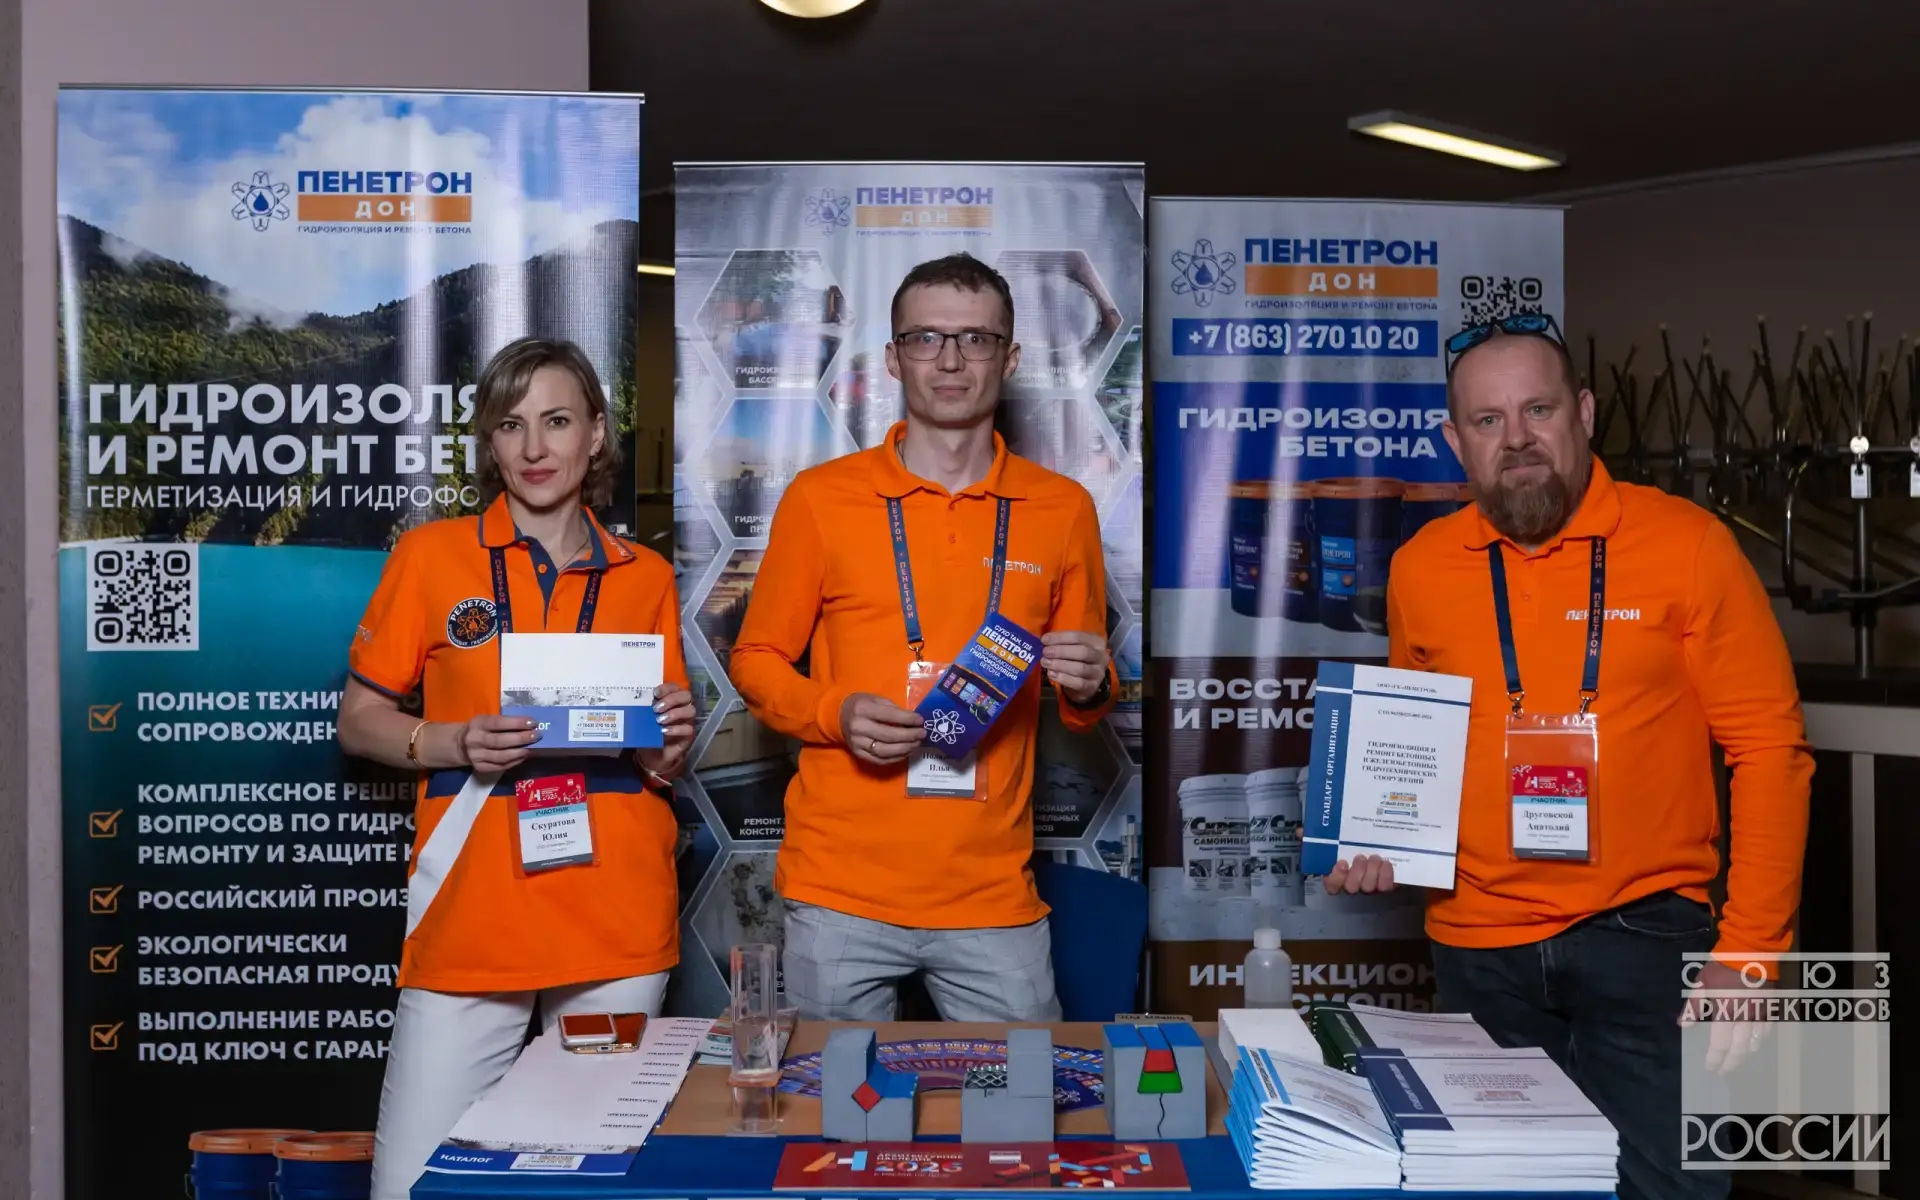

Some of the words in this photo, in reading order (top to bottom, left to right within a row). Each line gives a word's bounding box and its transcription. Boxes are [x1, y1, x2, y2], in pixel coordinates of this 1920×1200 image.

[298, 171, 472, 194] ПЕНЕТРОН
[856, 187, 993, 204] ПЕНЕТРОН
[355, 201, 415, 219] ДОН
[298, 226, 383, 234] ГИДРОИЗОЛЯЦИЯ
[435, 226, 472, 234] БЕТОНА
[1245, 238, 1438, 265] ПЕНЕТРОН
[1309, 272, 1376, 292] ДОН
[1351, 302, 1393, 310] РЕМОНТ
[1396, 302, 1438, 310] БЕТОНА
[1189, 325, 1220, 349] +7
[1226, 322, 1292, 355] (863)
[1297, 325, 1345, 349] 270
[1351, 325, 1382, 350] 10
[1388, 326, 1419, 351] 20
[88, 435, 127, 475] И
[147, 434, 379, 475] РЕМОНТ
[1280, 436, 1438, 458] БЕТОНА
[87, 485, 301, 511] ГЕРМЕТИЗАЦИЯ
[312, 486, 331, 508] И
[900, 561, 914, 618] ПЕНЕТРОН
[450, 599, 498, 621] PENETRON
[994, 625, 1011, 637] СУХО
[1589, 592, 1601, 656] ПЕНЕТРОН
[981, 626, 1035, 664] ПЕНЕТРОН
[990, 644, 1015, 662] ДОН
[969, 647, 1018, 680] ГИДРОИЗОЛЯЦИЯ
[975, 644, 1020, 675] ПРОНИКАЮЩАЯ
[979, 661, 1001, 677] БЕТОНА
[138, 691, 250, 711] ПОЛНОЕ
[256, 691, 344, 710] ТЕХНИ
[1173, 707, 1200, 729] И
[1327, 709, 1339, 776] ОРГАНИЗАЦИИ
[1366, 749, 1395, 757] РЕМОНТ
[1396, 752, 1436, 761] БЕТОННЫХ
[138, 782, 336, 804] КОМПЛЕКСНОЕ
[1322, 779, 1333, 826] СТАНДАРТ
[534, 806, 570, 817] УЧАСТНИК
[743, 817, 782, 826] РЕМОНТ
[1522, 810, 1574, 820] Друговской
[138, 814, 283, 834] ВОПРОСОВ
[291, 813, 330, 833] ПО
[531, 818, 576, 831] Скуратова
[1527, 823, 1570, 831] Анатолий
[542, 831, 568, 842] Юлия
[138, 844, 259, 864] РЕМОНТУ
[267, 844, 284, 864] И
[292, 843, 397, 866] ЗАЩИТЕ
[138, 884, 316, 910] РОССИЙСКИЙ
[138, 934, 347, 955] ЭКОЛОГИЧЕСКИ
[138, 965, 309, 985] БЕЗОПАСНАЯ
[138, 1010, 320, 1031] ВЫПОЛНЕНИЕ
[138, 1043, 198, 1065] ПОД
[205, 1041, 286, 1061] КЛЮЧ
[293, 1041, 309, 1060] С
[440, 1154, 495, 1163] КАТАЛОГ
